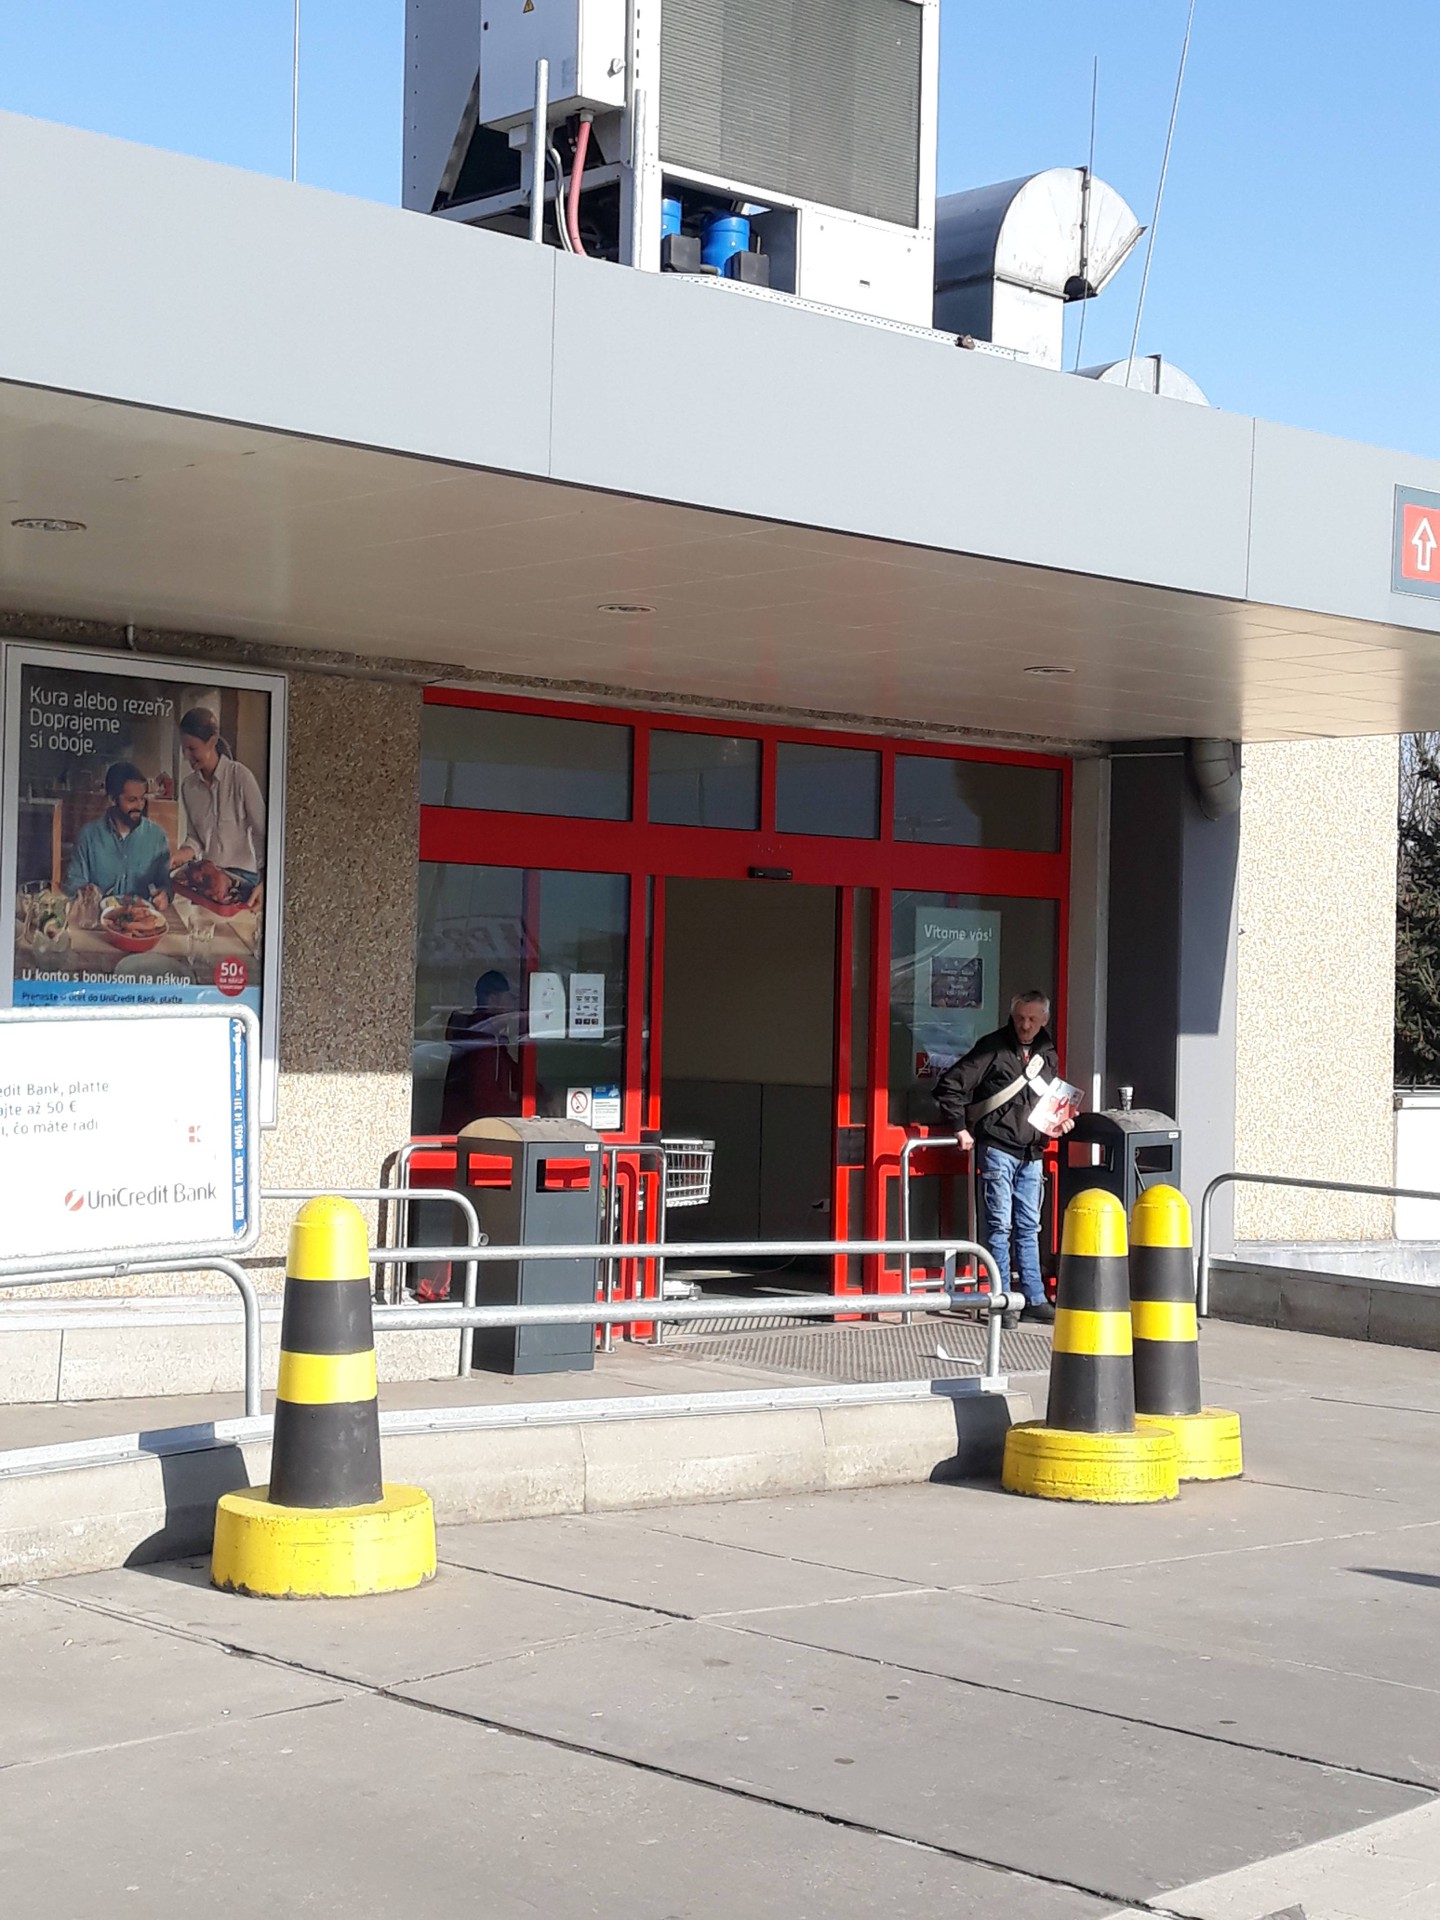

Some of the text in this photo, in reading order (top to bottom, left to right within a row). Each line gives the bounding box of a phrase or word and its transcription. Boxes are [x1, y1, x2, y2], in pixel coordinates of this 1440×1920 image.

[30, 686, 174, 717] Kura alebo rezeň?
[30, 708, 120, 734] Doprajeme
[29, 730, 97, 756] si oboje.
[969, 927, 992, 942] vás!
[22, 967, 191, 987] U konto s bonusom na nákup
[27, 1082, 64, 1097] Bank,
[47, 1100, 64, 1114] 50
[69, 1100, 76, 1113] €
[34, 1120, 68, 1133] máte
[88, 1182, 217, 1209] UniCredit Bank
